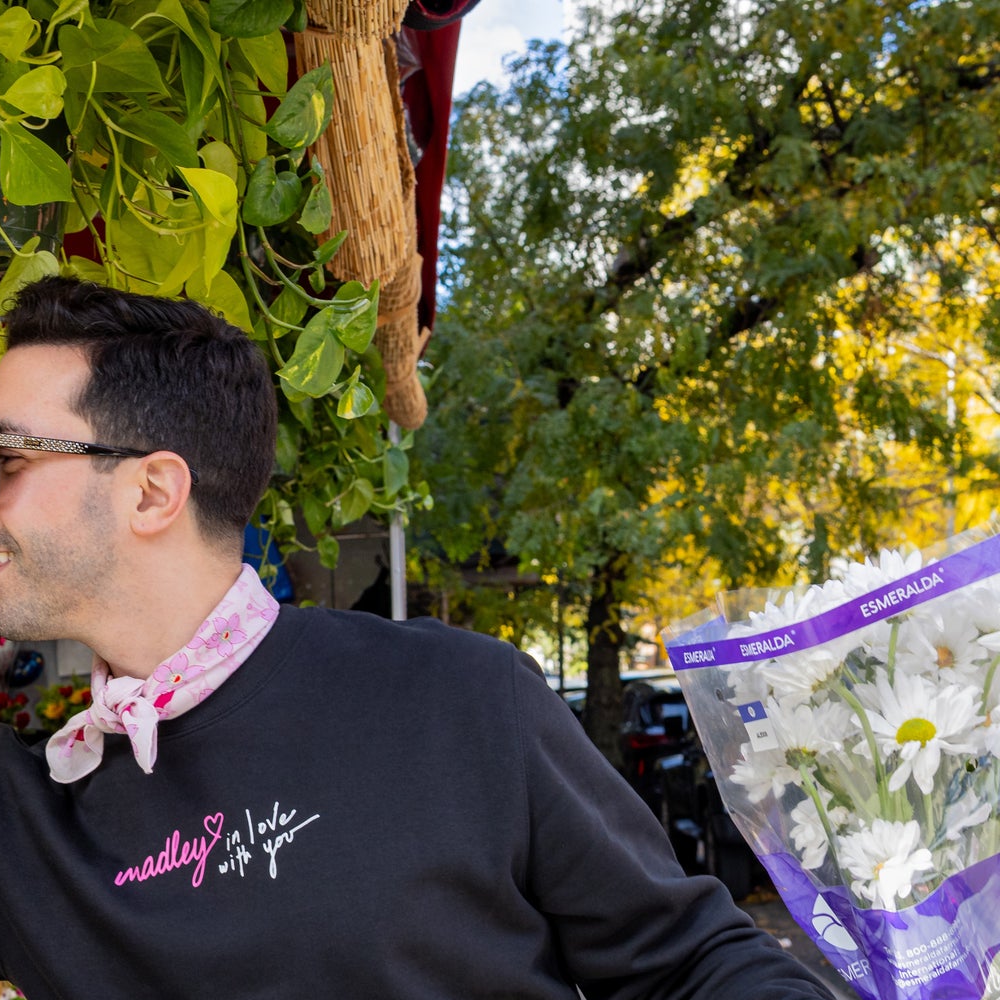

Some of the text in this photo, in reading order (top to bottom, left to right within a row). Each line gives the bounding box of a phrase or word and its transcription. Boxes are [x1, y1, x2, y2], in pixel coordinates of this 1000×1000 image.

[860, 569, 945, 619] ESMERALDA
[739, 633, 796, 658] ESMERALDA
[218, 814, 320, 879] with you
[226, 801, 297, 851] in love
